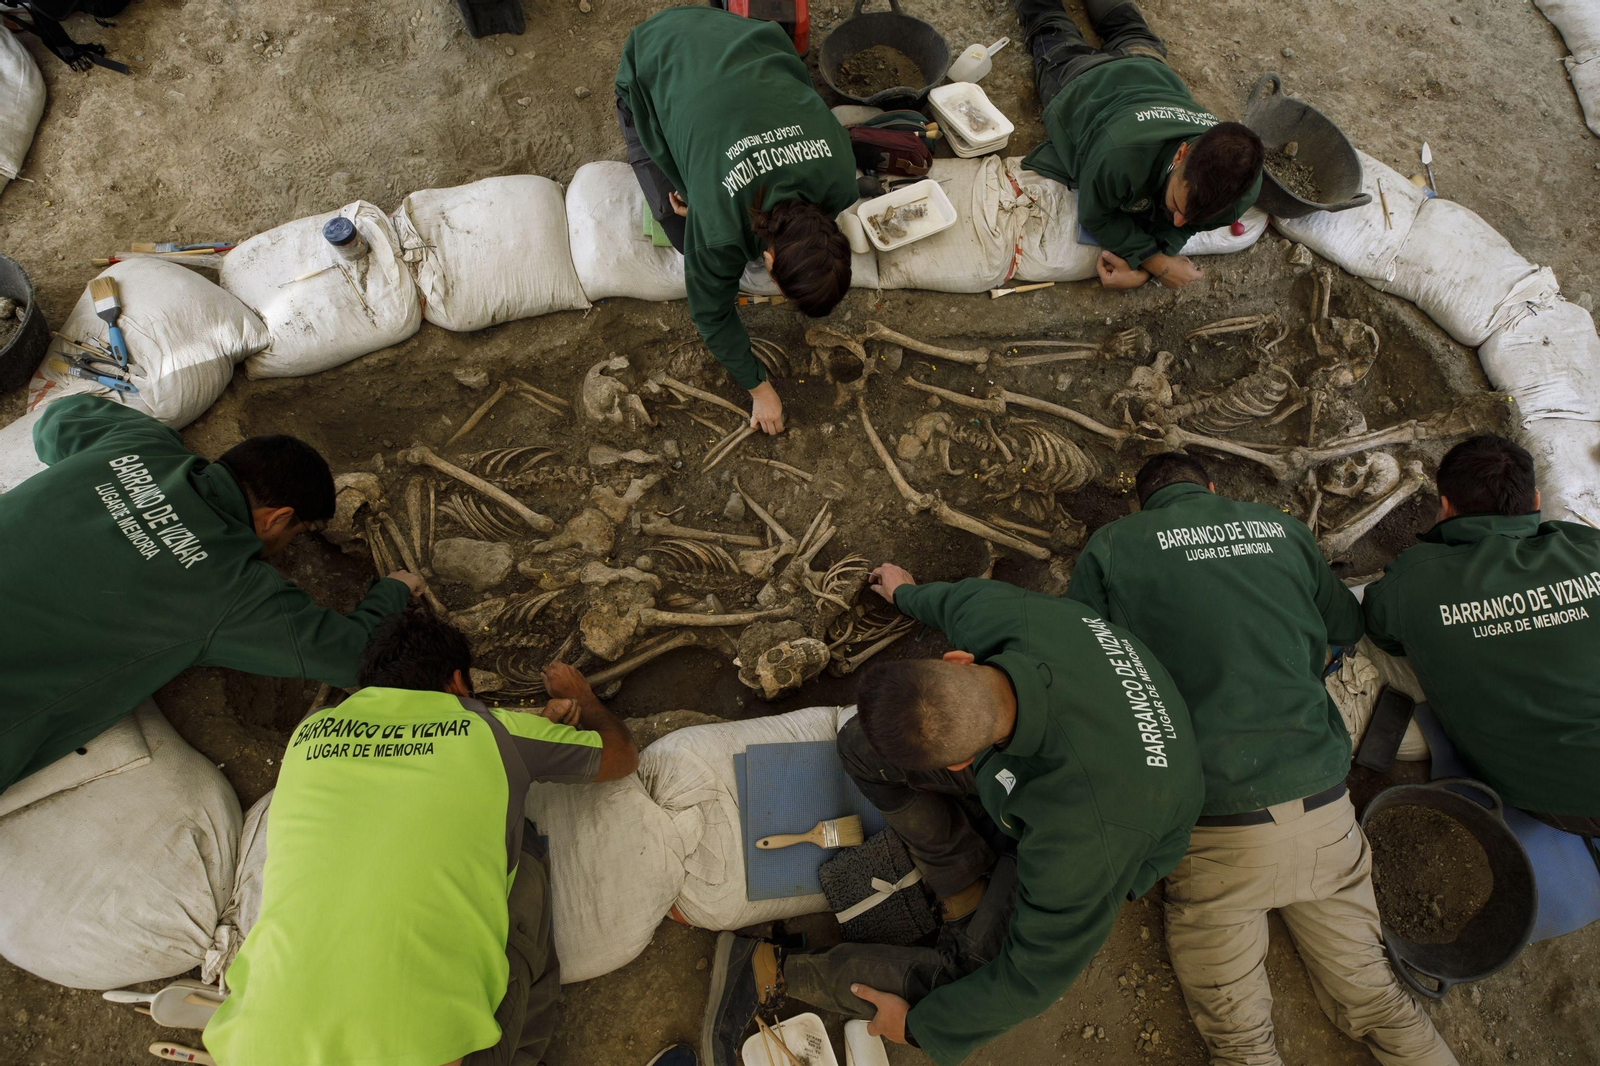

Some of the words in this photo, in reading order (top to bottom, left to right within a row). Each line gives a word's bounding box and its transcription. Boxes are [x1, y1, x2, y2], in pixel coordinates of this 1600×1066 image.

[1135, 109, 1176, 122] VIZNAR
[1177, 113, 1191, 123] DE
[761, 130, 776, 144] DE
[774, 124, 804, 140] LUGAR
[725, 134, 763, 161] MEMORIA
[752, 149, 774, 175] DE
[770, 139, 833, 167] BARRANCO
[722, 157, 759, 198] VIZNAR
[108, 454, 166, 509] BARRANO
[94, 482, 126, 513] LUGAR
[116, 515, 161, 561] MEMORIA
[142, 503, 179, 530] DE
[157, 522, 209, 570] VIZNAR
[1156, 525, 1226, 551] BARRANCO
[1224, 521, 1245, 541] DE
[1241, 520, 1287, 539] VIZNAR
[1185, 547, 1218, 562] LUGAR
[1217, 545, 1231, 559] DE
[1231, 542, 1274, 557] MEMORIA
[1439, 592, 1526, 626] BARRANCO
[1526, 586, 1552, 612] DE
[1549, 571, 1600, 606] VIZNAR
[1081, 617, 1125, 657] VIZNAR
[1472, 621, 1514, 639] LUGAR
[1514, 618, 1532, 633] DE
[1532, 606, 1590, 630] MEMORIA
[1109, 658, 1137, 678] DE
[1121, 638, 1152, 683] MEMORIA
[1145, 683, 1161, 699] DE
[292, 716, 381, 748] BARRANCO
[381, 724, 409, 739] DE
[411, 719, 471, 739] VIZNAR
[1121, 679, 1168, 768] BARRANCO
[1153, 700, 1178, 740] LUGAR
[305, 743, 351, 761] LUGAR
[352, 743, 372, 758] DE
[373, 742, 434, 758] MEMORIA
